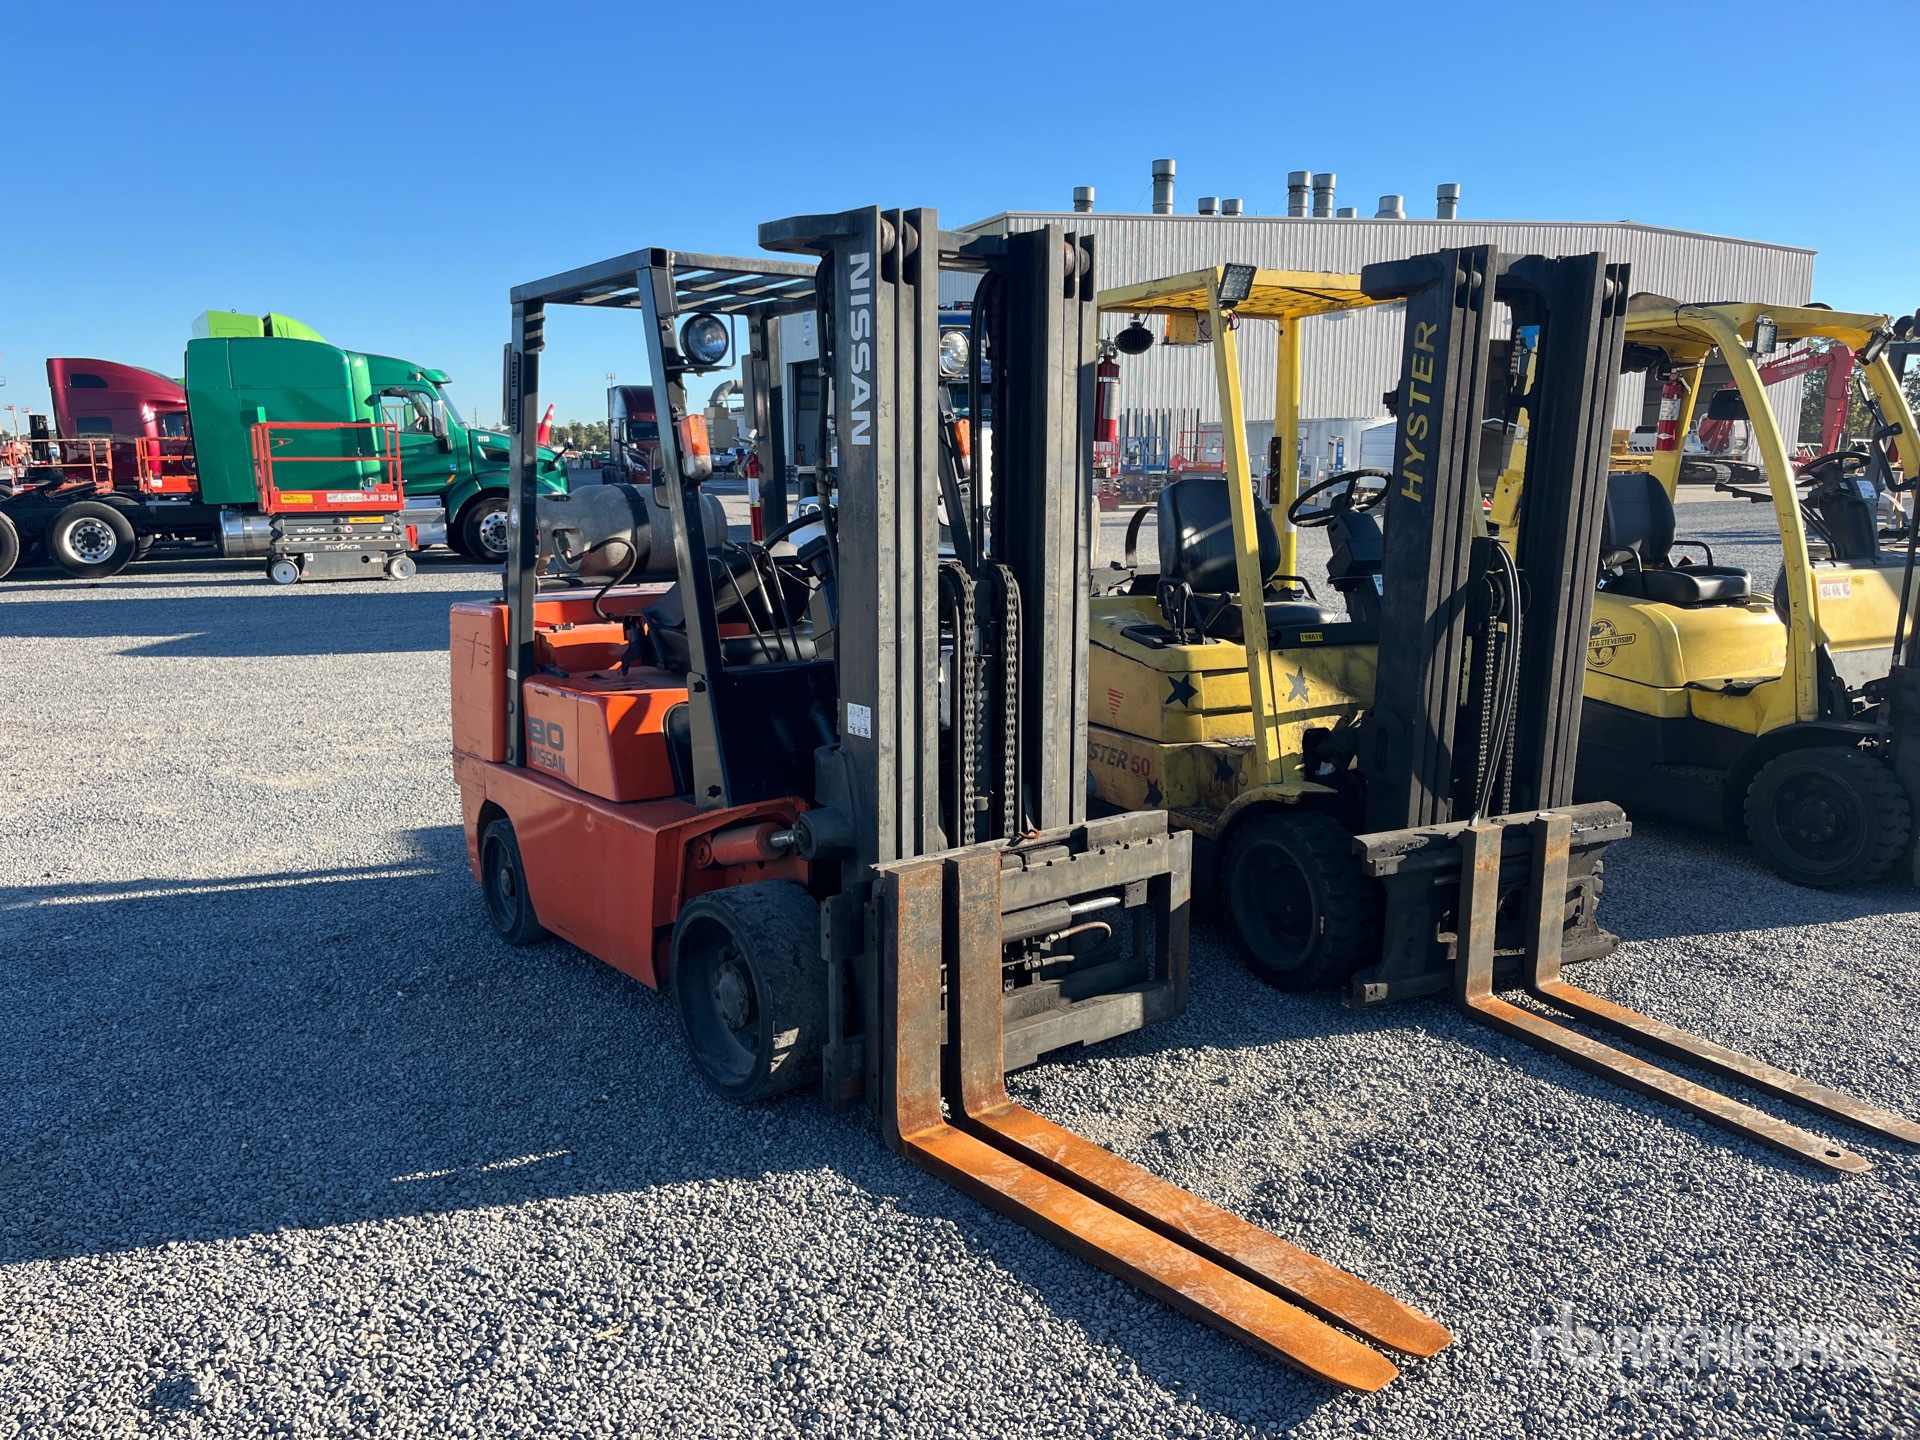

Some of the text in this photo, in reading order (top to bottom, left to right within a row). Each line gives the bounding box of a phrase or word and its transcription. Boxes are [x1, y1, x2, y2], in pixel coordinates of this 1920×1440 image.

[850, 252, 871, 446] NISSAN
[1401, 321, 1438, 502] HYSTER
[380, 493, 398, 502] 3219
[296, 526, 326, 534] SKYJACK
[1600, 635, 1633, 646] STEVENSON
[527, 716, 565, 752] 80
[530, 745, 566, 775] NISSAN
[1087, 742, 1151, 778] STER 50
